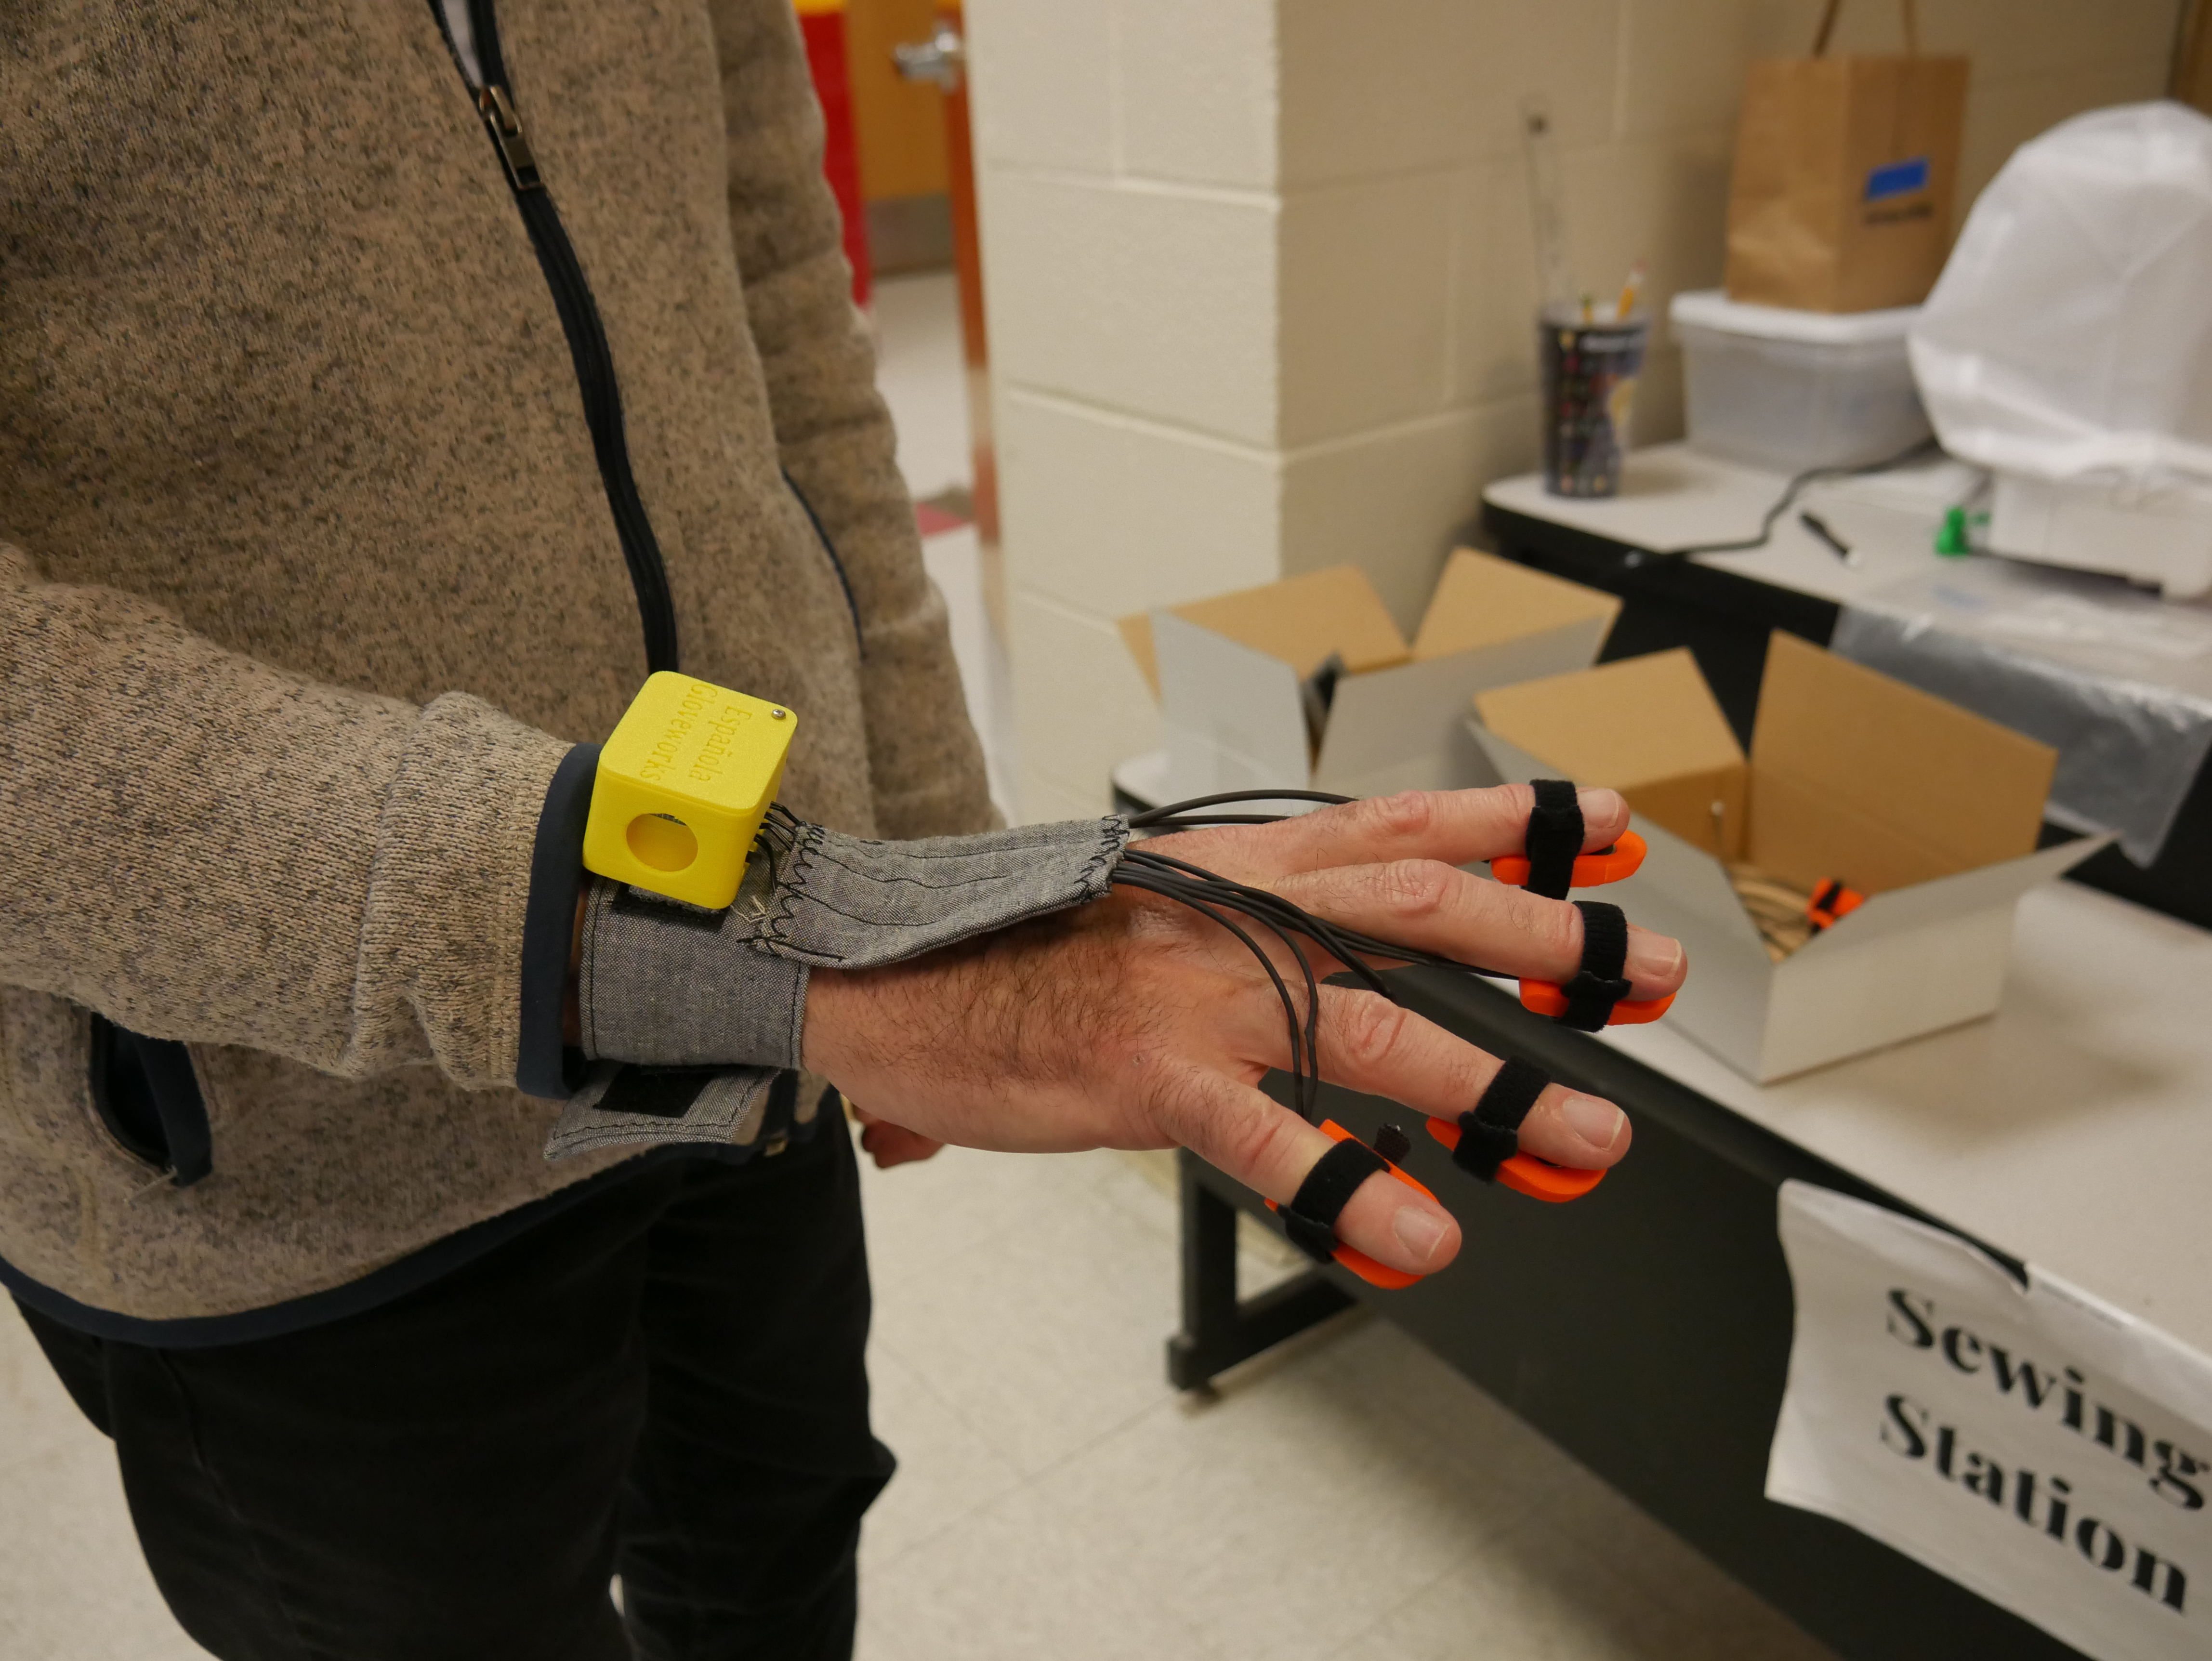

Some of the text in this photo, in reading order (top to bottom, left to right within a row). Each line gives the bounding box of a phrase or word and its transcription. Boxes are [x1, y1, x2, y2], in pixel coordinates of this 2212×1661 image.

[640, 684, 718, 781] Gloveworks
[688, 705, 752, 782] Española
[1886, 1289, 2211, 1511] Sewing
[1880, 1393, 2187, 1615] Station
